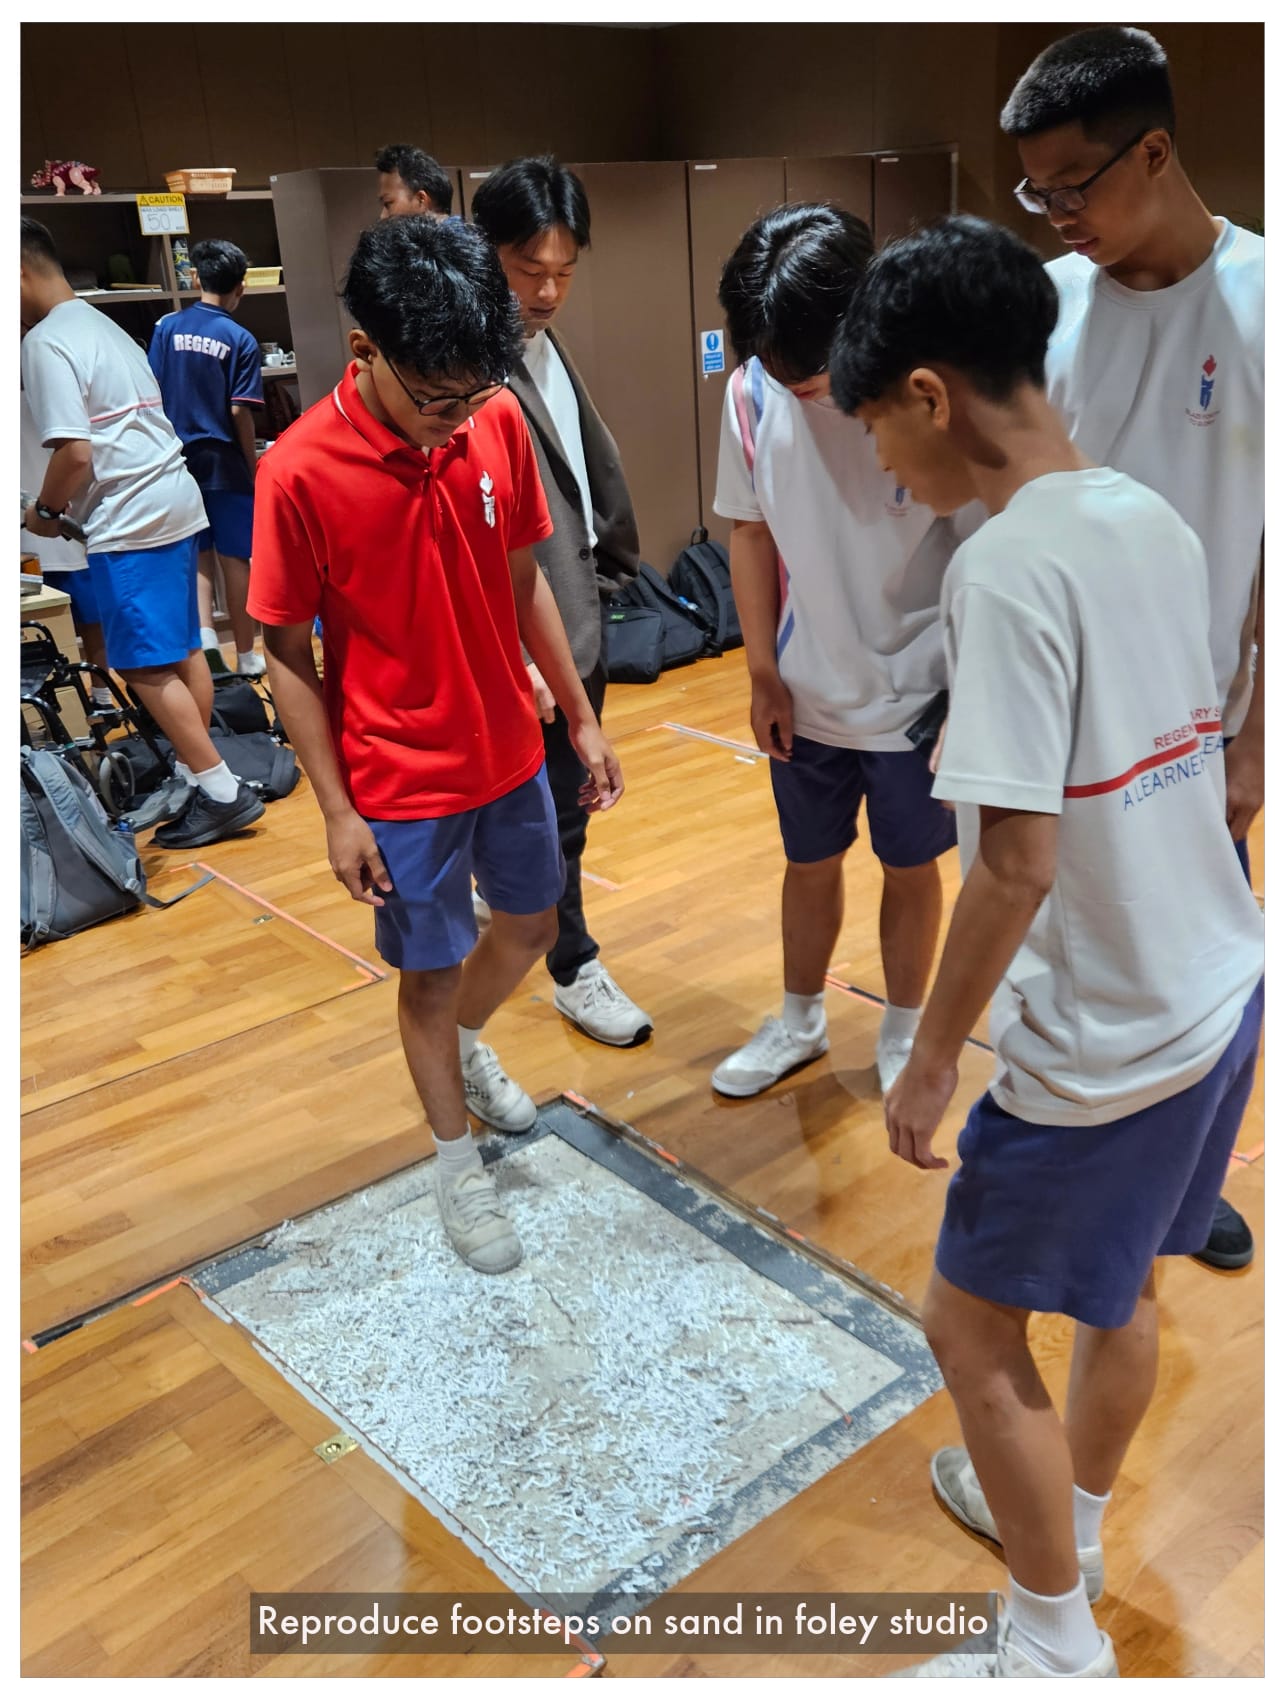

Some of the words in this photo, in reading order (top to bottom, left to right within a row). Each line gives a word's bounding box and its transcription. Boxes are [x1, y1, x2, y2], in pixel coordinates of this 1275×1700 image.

[148, 196, 183, 204] CAUTION
[147, 213, 171, 231] 50
[173, 334, 231, 361] REGENT
[1124, 789, 1135, 811] A
